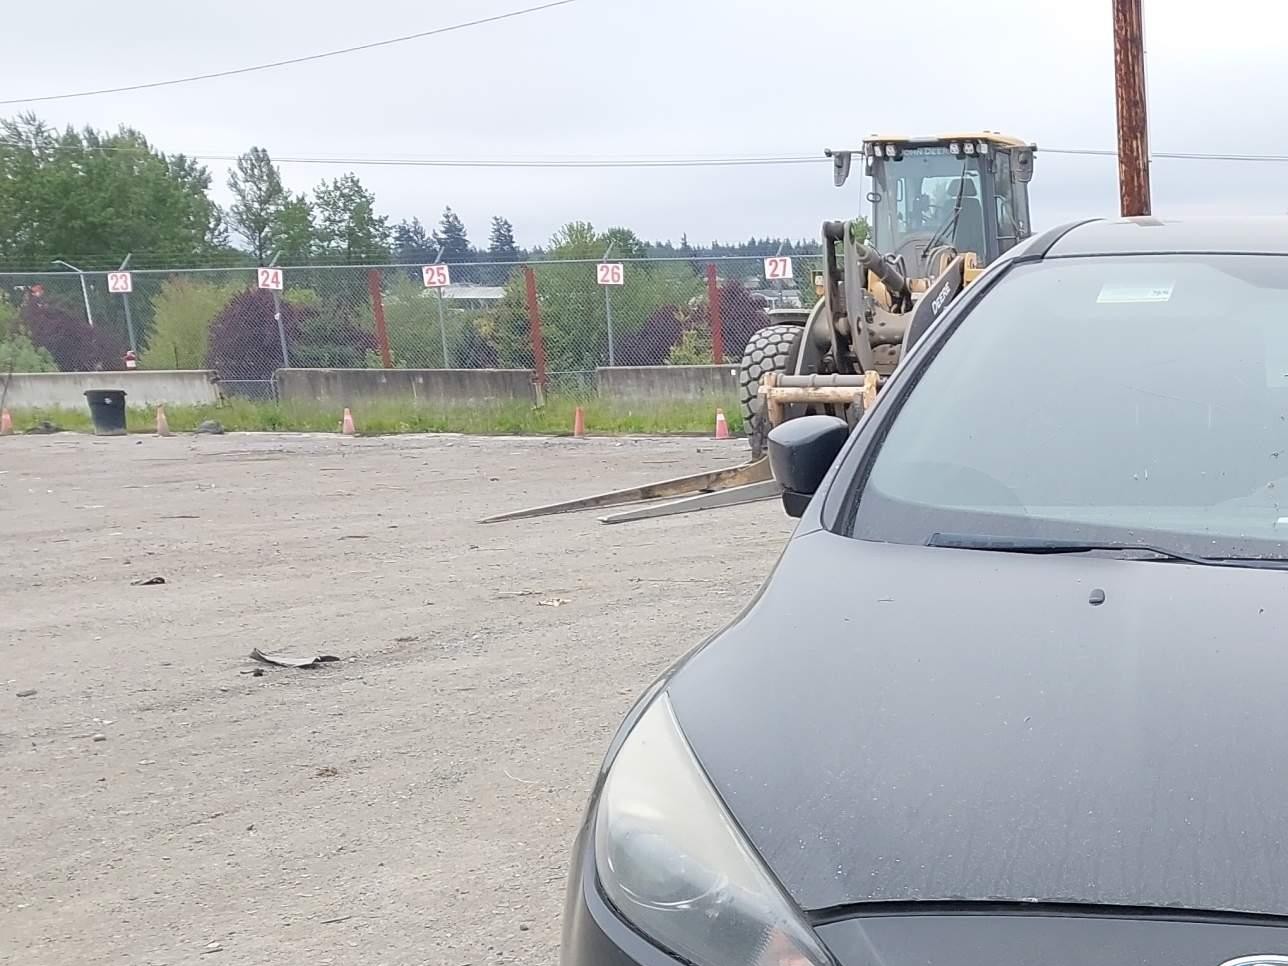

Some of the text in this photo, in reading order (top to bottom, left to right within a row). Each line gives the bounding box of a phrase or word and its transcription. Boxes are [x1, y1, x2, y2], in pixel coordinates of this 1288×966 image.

[425, 267, 447, 285] 25
[599, 264, 621, 284] 26
[768, 259, 788, 278] 27
[110, 273, 129, 291] 23
[260, 269, 281, 289] 24
[931, 281, 951, 315] DEERE
